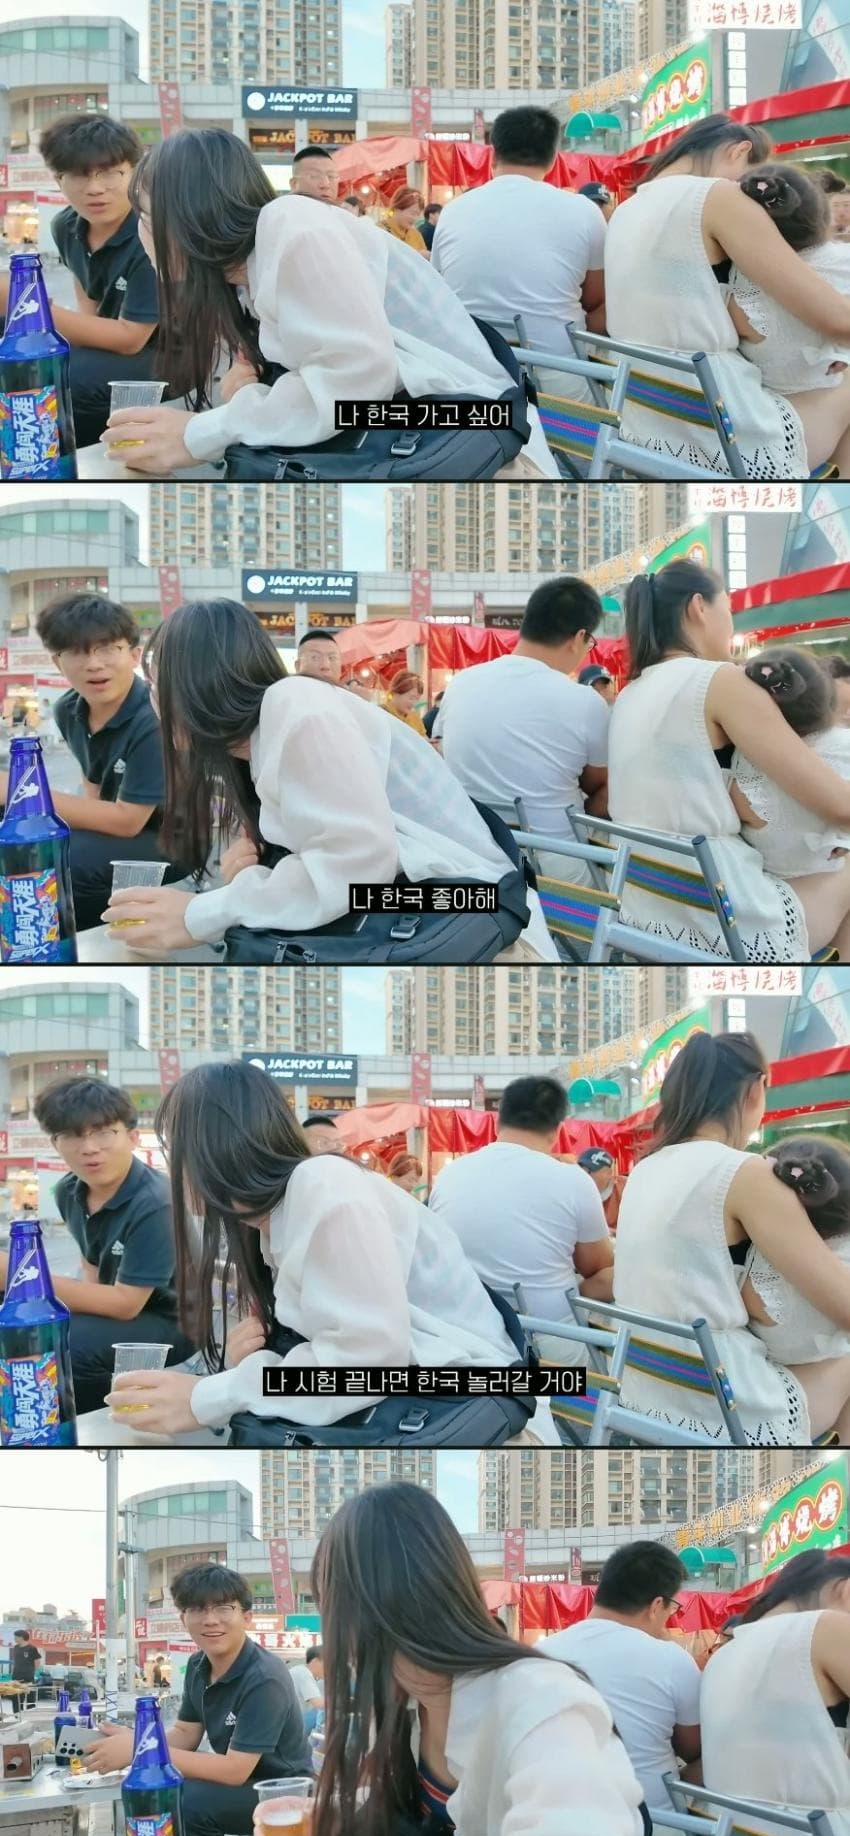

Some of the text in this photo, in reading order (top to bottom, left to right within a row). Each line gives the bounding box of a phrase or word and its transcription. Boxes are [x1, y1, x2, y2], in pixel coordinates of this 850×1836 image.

[267, 92, 354, 104] JACKPOT BAR
[267, 575, 354, 587] JACKPOT BAR
[267, 1058, 354, 1070] JACKPOT BAR
